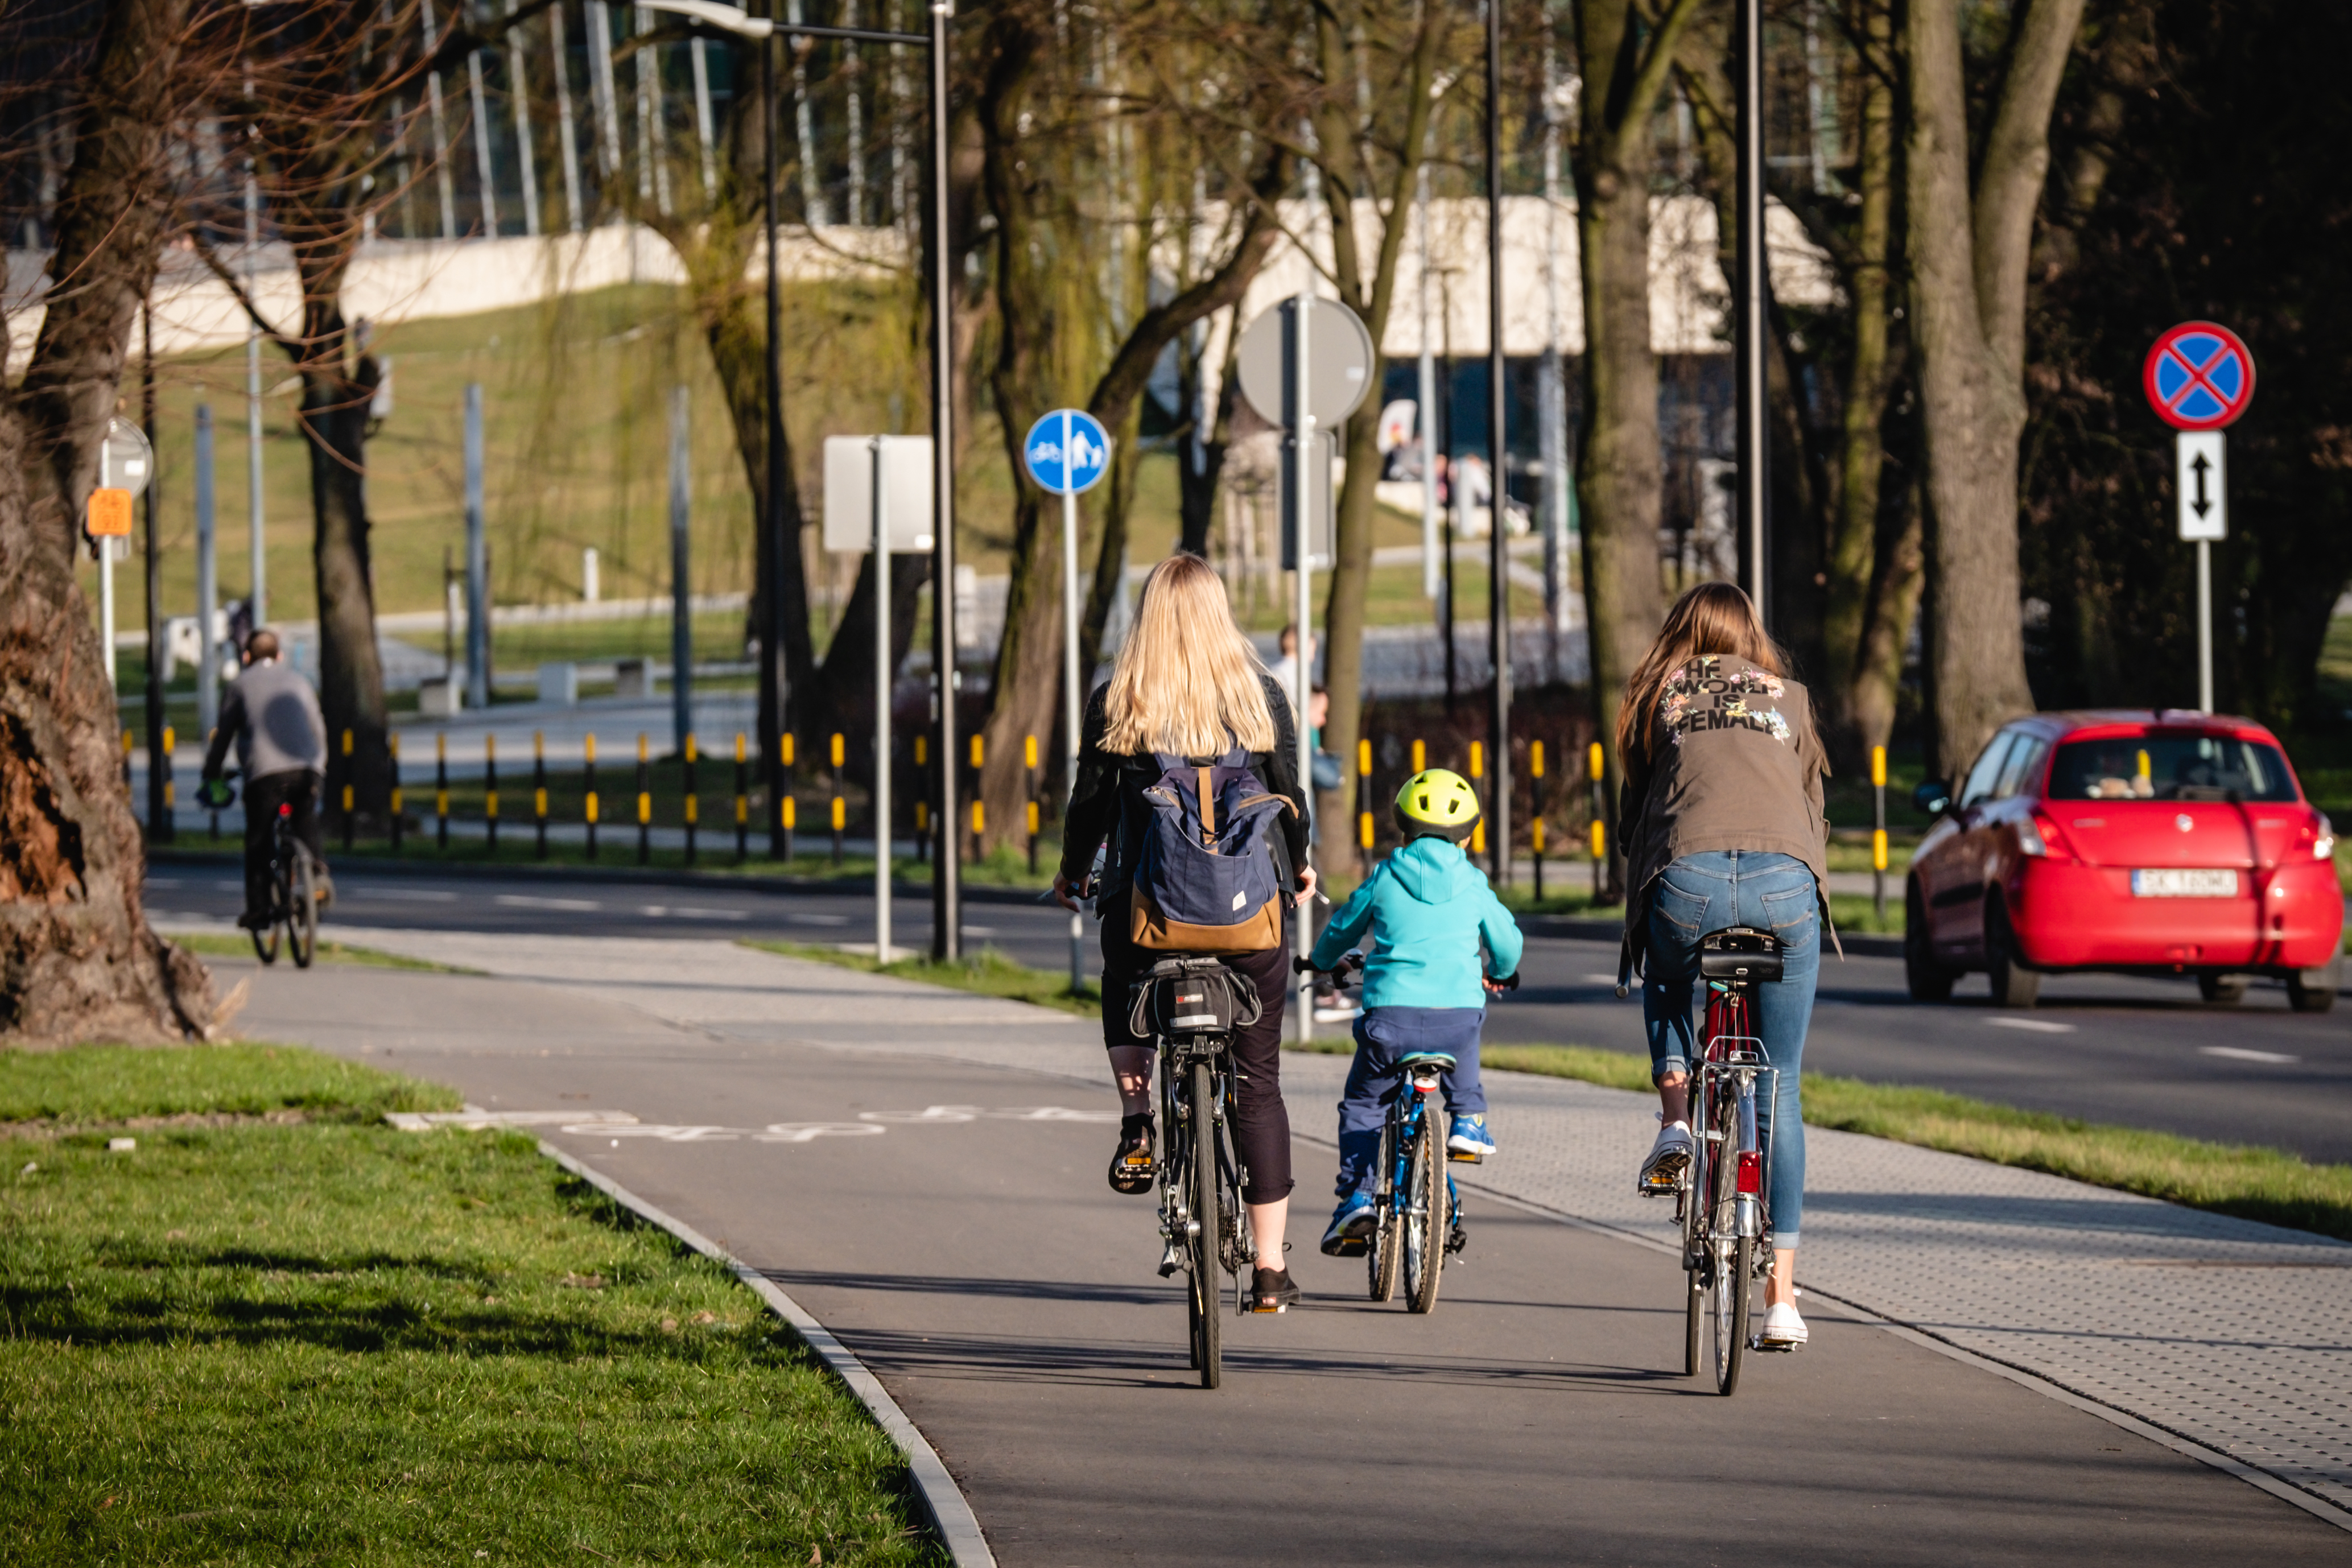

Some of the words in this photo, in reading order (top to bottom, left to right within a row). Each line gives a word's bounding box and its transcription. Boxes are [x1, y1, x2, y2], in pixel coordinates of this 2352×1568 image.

[1681, 659, 1721, 678] HE
[1676, 679, 1768, 695] WORL
[1714, 694, 1740, 708] IS
